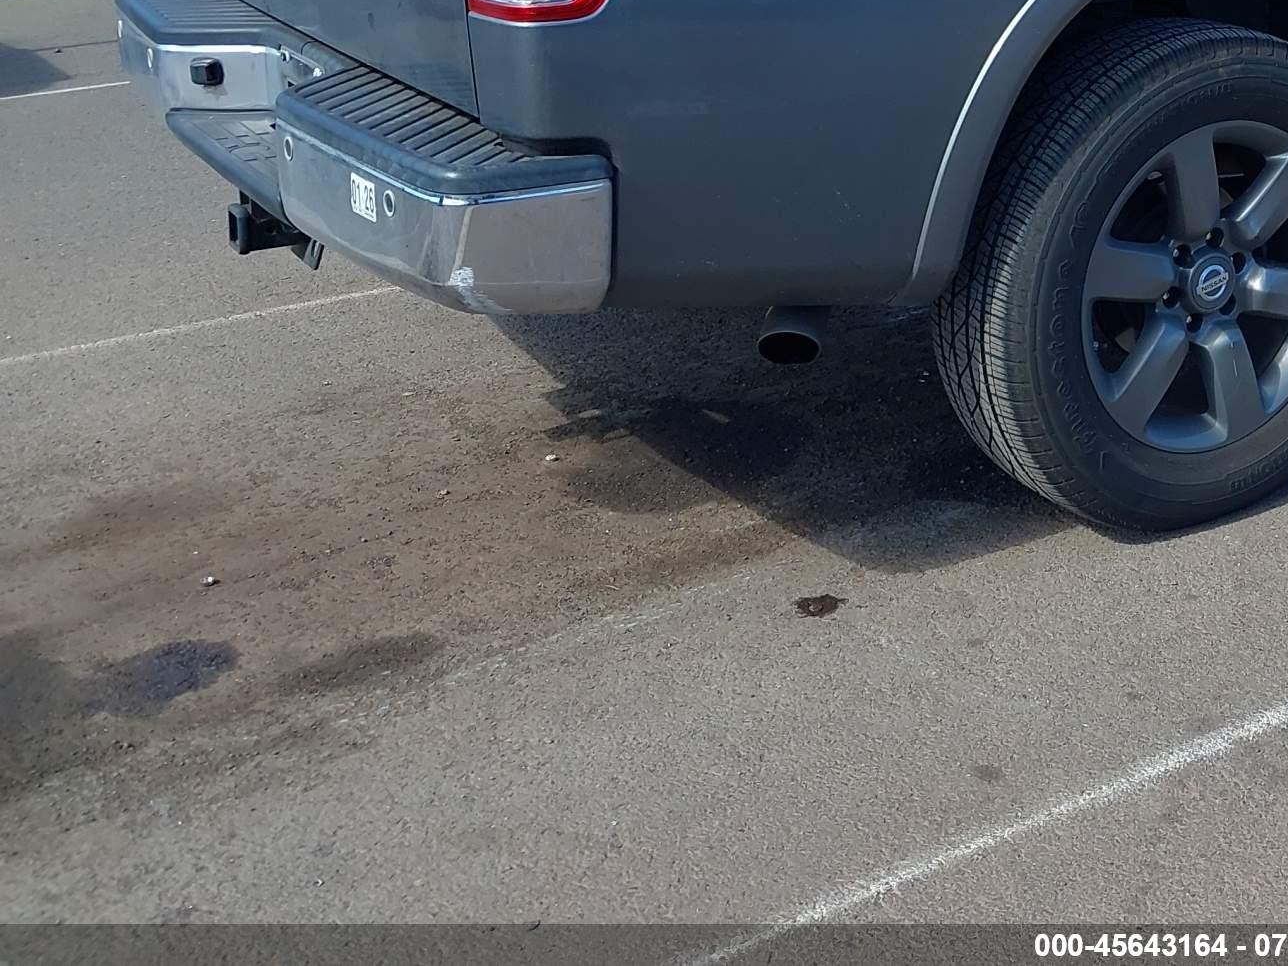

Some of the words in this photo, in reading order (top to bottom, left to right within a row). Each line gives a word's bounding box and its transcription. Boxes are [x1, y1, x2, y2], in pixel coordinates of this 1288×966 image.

[351, 179, 361, 206] 01
[364, 185, 374, 213] 26
[1201, 275, 1227, 292] NISSAN
